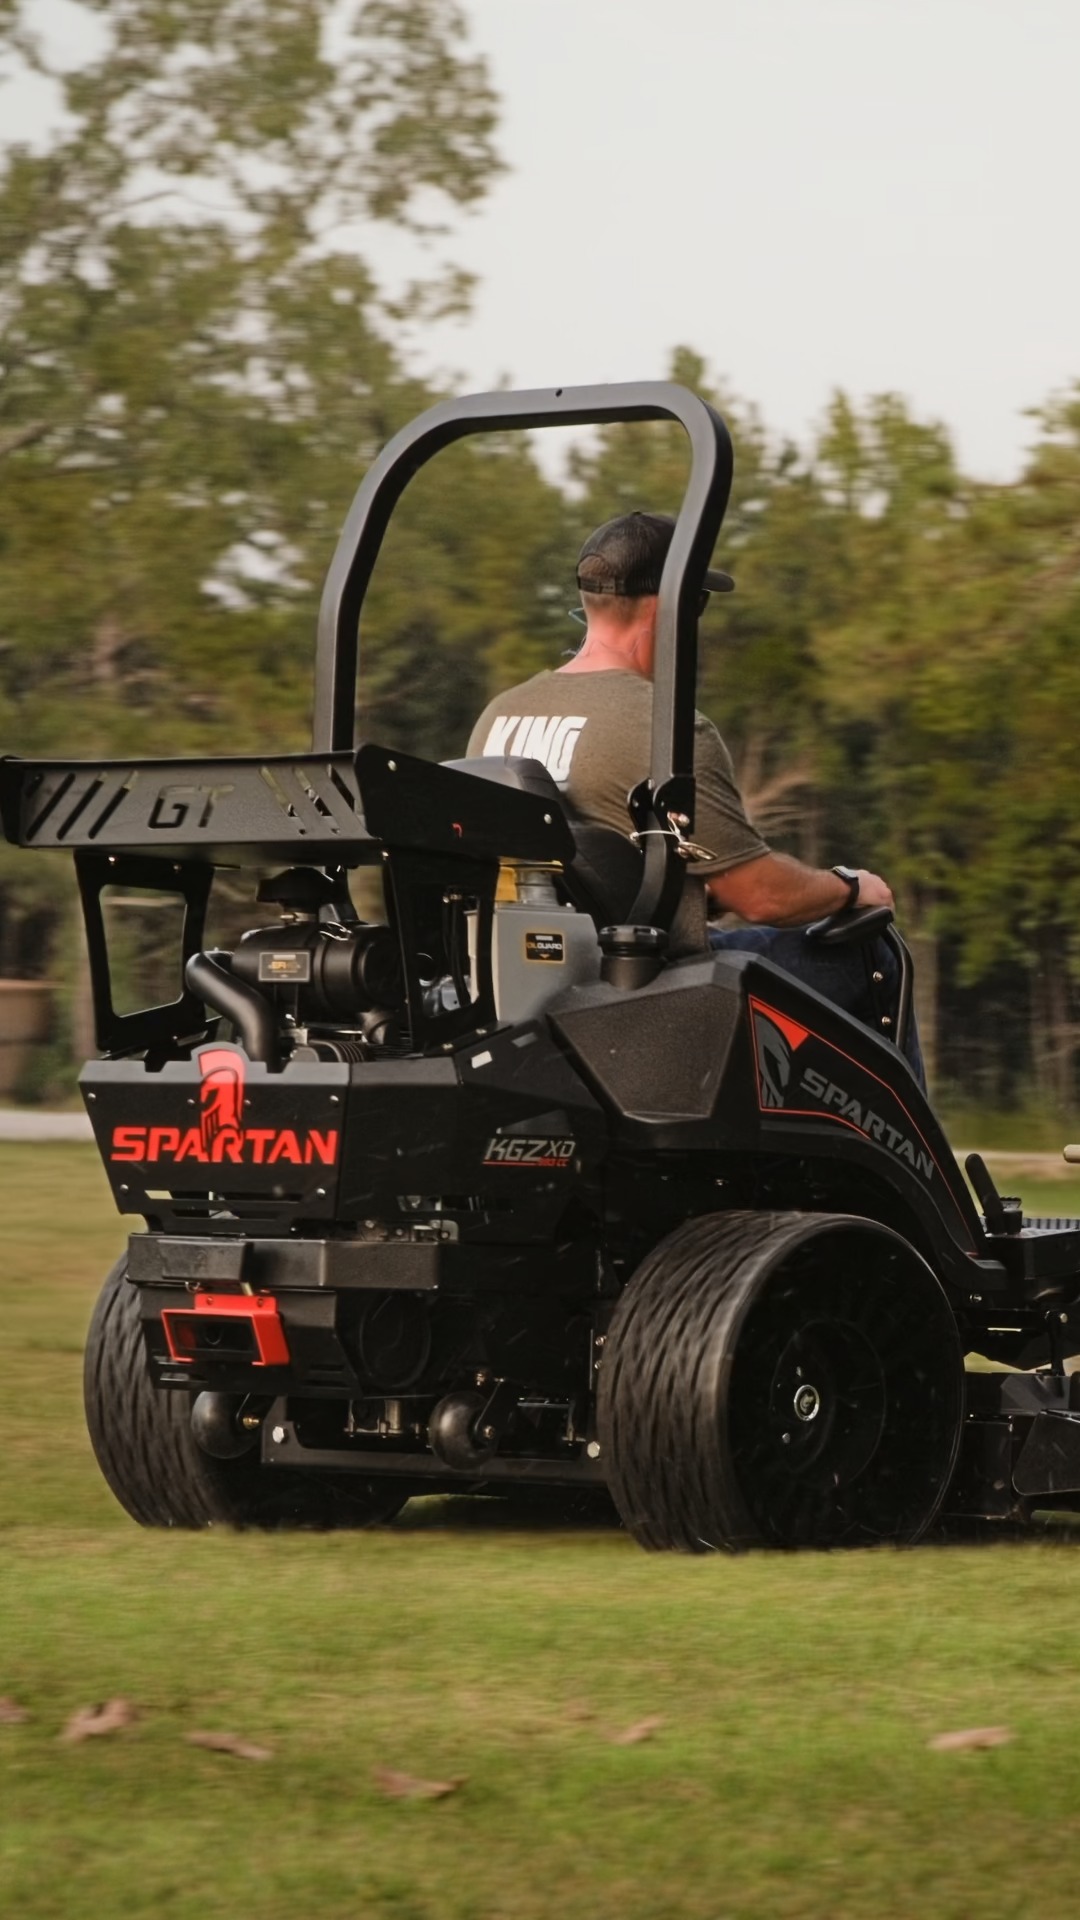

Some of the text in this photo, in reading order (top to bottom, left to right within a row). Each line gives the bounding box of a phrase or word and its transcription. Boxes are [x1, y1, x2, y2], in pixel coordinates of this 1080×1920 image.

[483, 716, 588, 784] KING
[147, 784, 234, 830] GT
[110, 1126, 338, 1165] SPARTAN
[800, 1066, 935, 1180] SPARTAN
